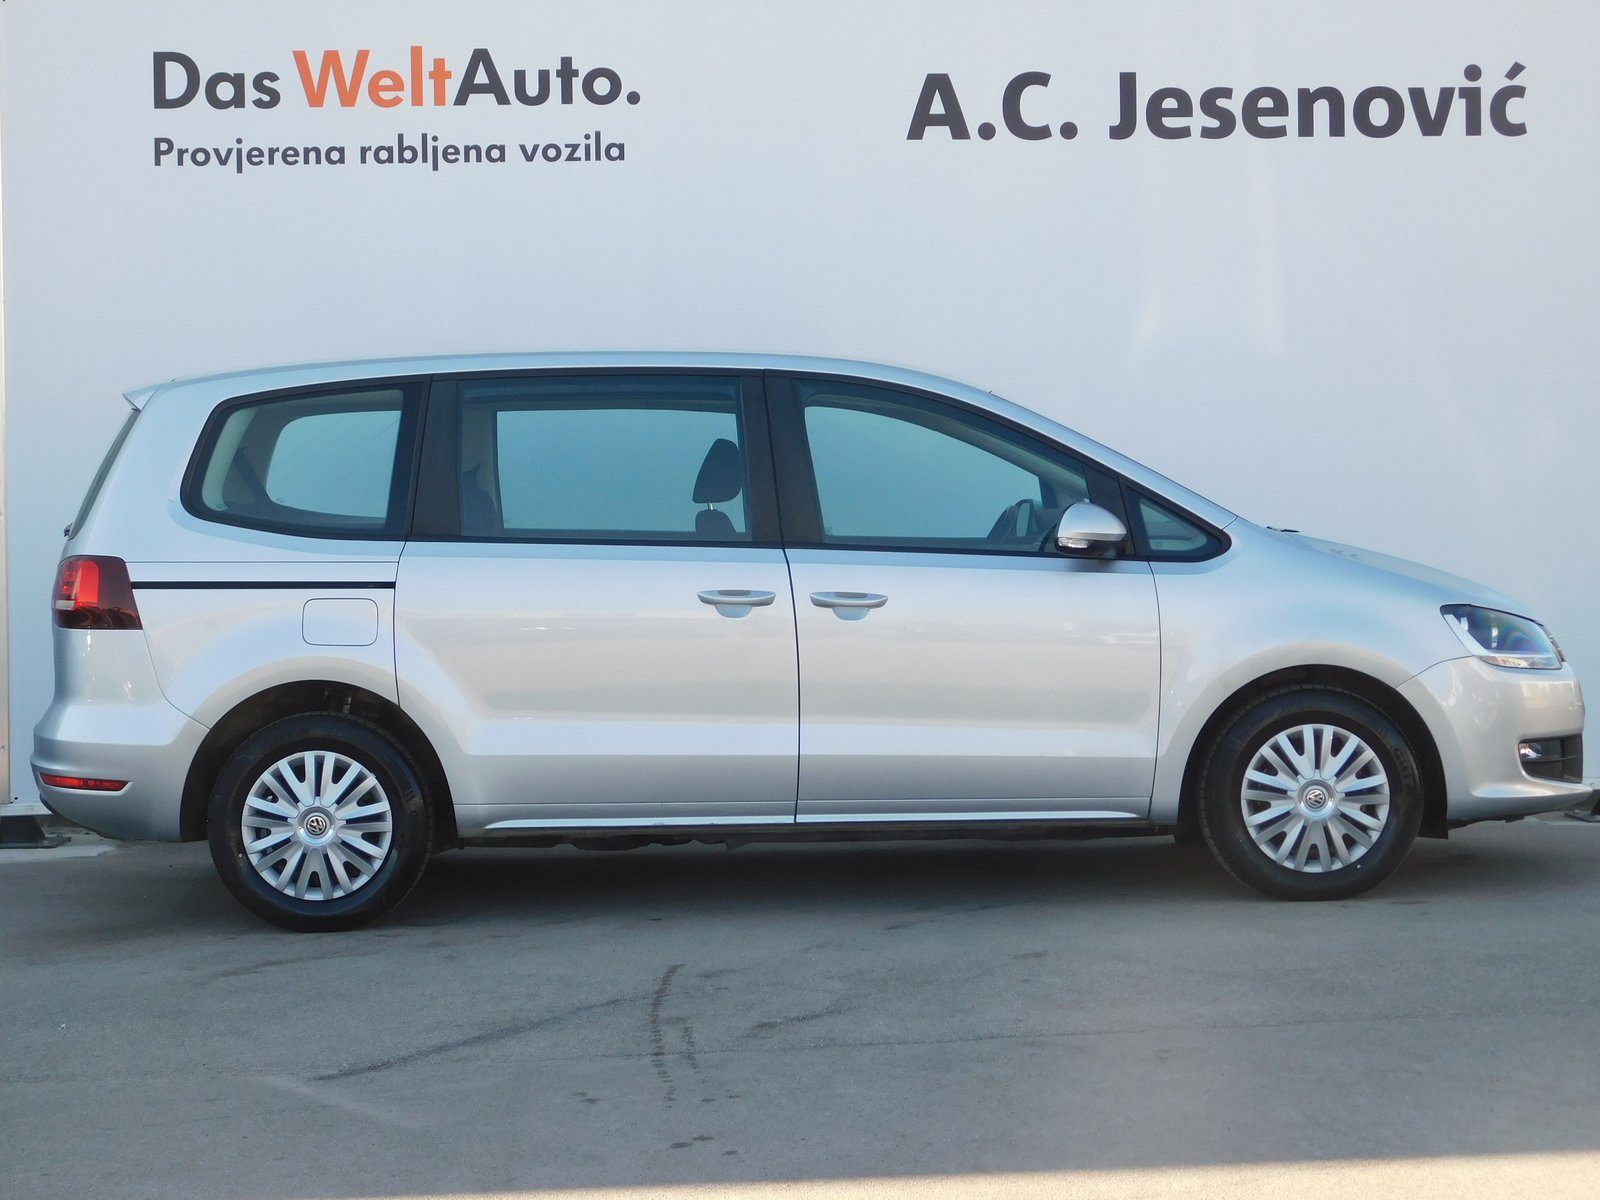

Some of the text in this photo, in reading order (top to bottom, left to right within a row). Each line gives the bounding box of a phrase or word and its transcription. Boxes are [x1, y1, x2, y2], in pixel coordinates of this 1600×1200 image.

[152, 51, 281, 110] Das
[906, 61, 1528, 141] A.C. Jesenović
[154, 130, 625, 174] Provjerena rabljena vozila
